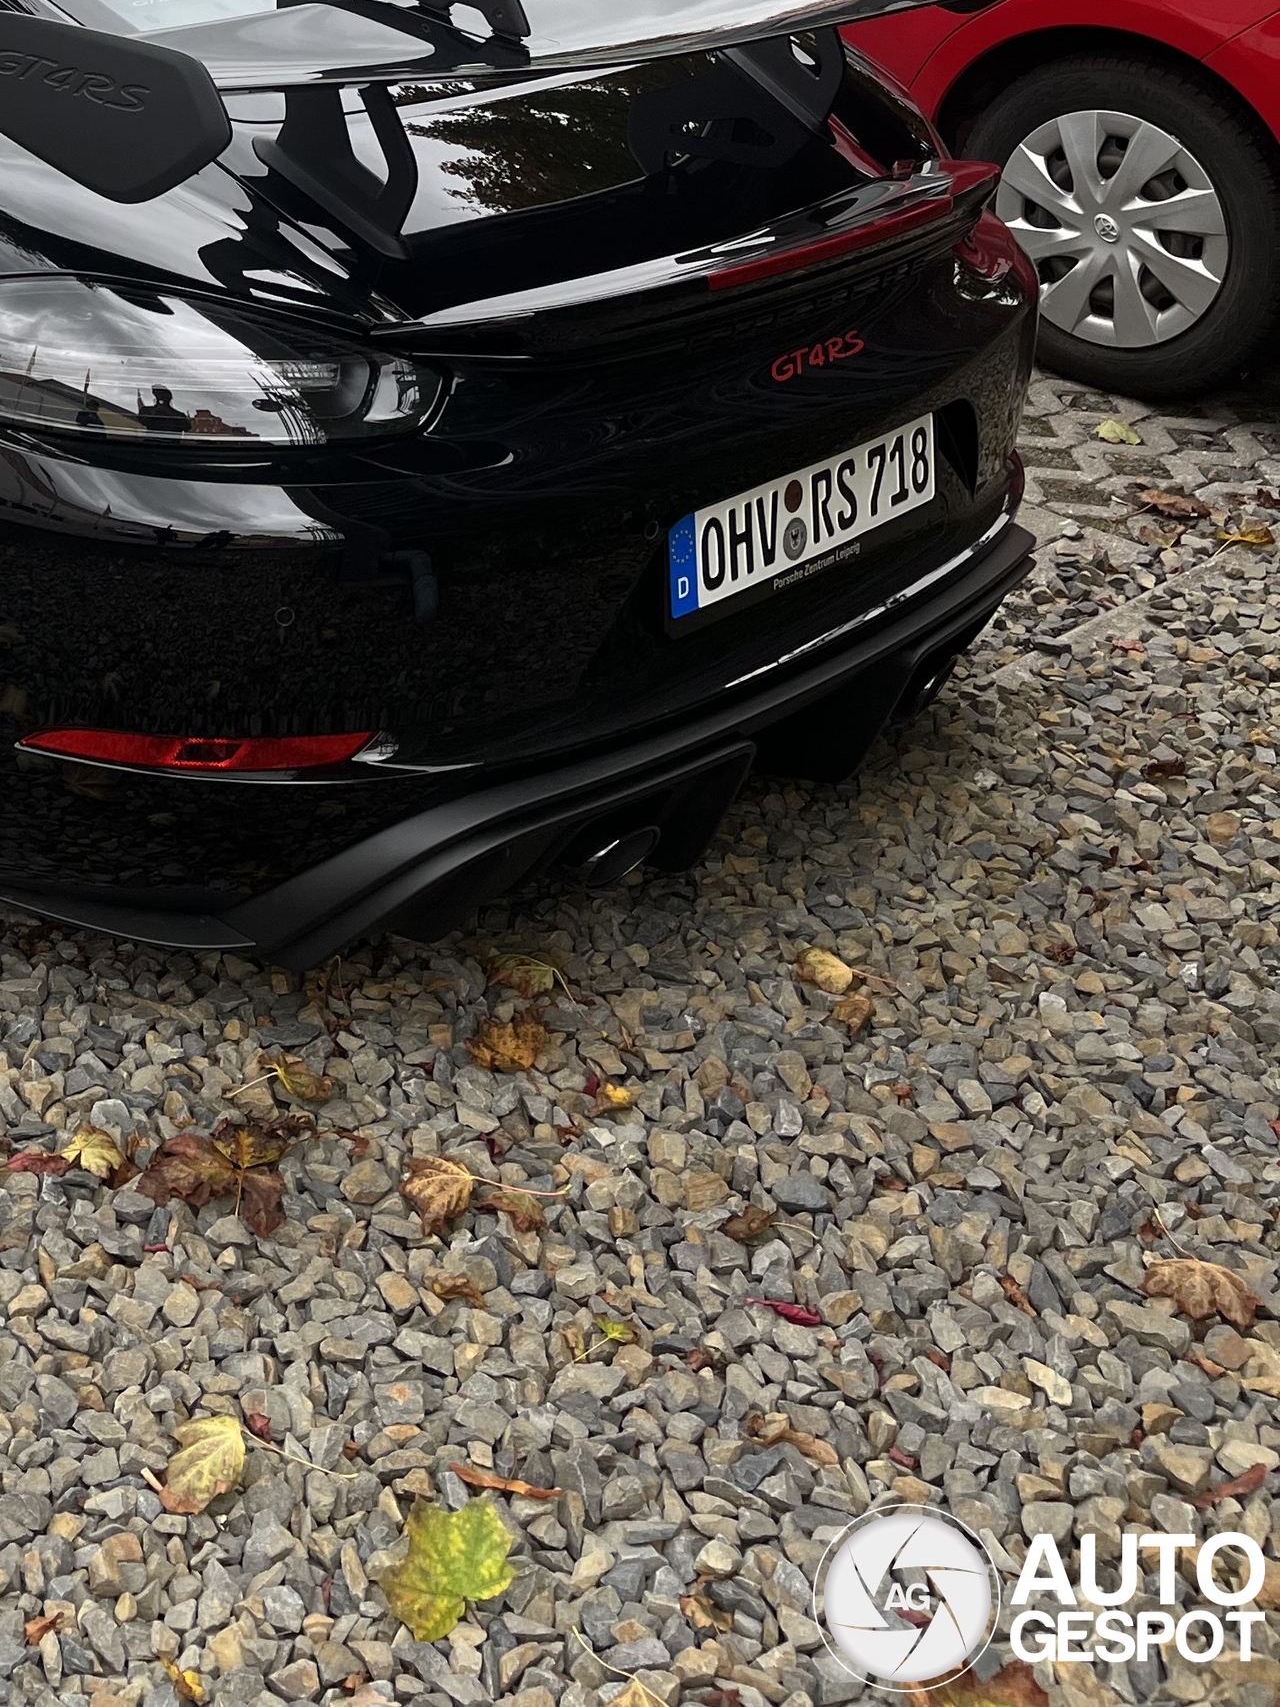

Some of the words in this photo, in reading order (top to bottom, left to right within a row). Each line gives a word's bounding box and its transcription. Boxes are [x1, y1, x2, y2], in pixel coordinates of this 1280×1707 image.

[771, 329, 865, 382] GT4RS
[701, 490, 778, 592] OHV
[810, 458, 858, 545] RS
[867, 426, 929, 518] 718
[678, 576, 690, 600] D
[773, 569, 804, 591] Porsche
[804, 554, 835, 576] Zentrum
[835, 541, 861, 561] Leipzig
